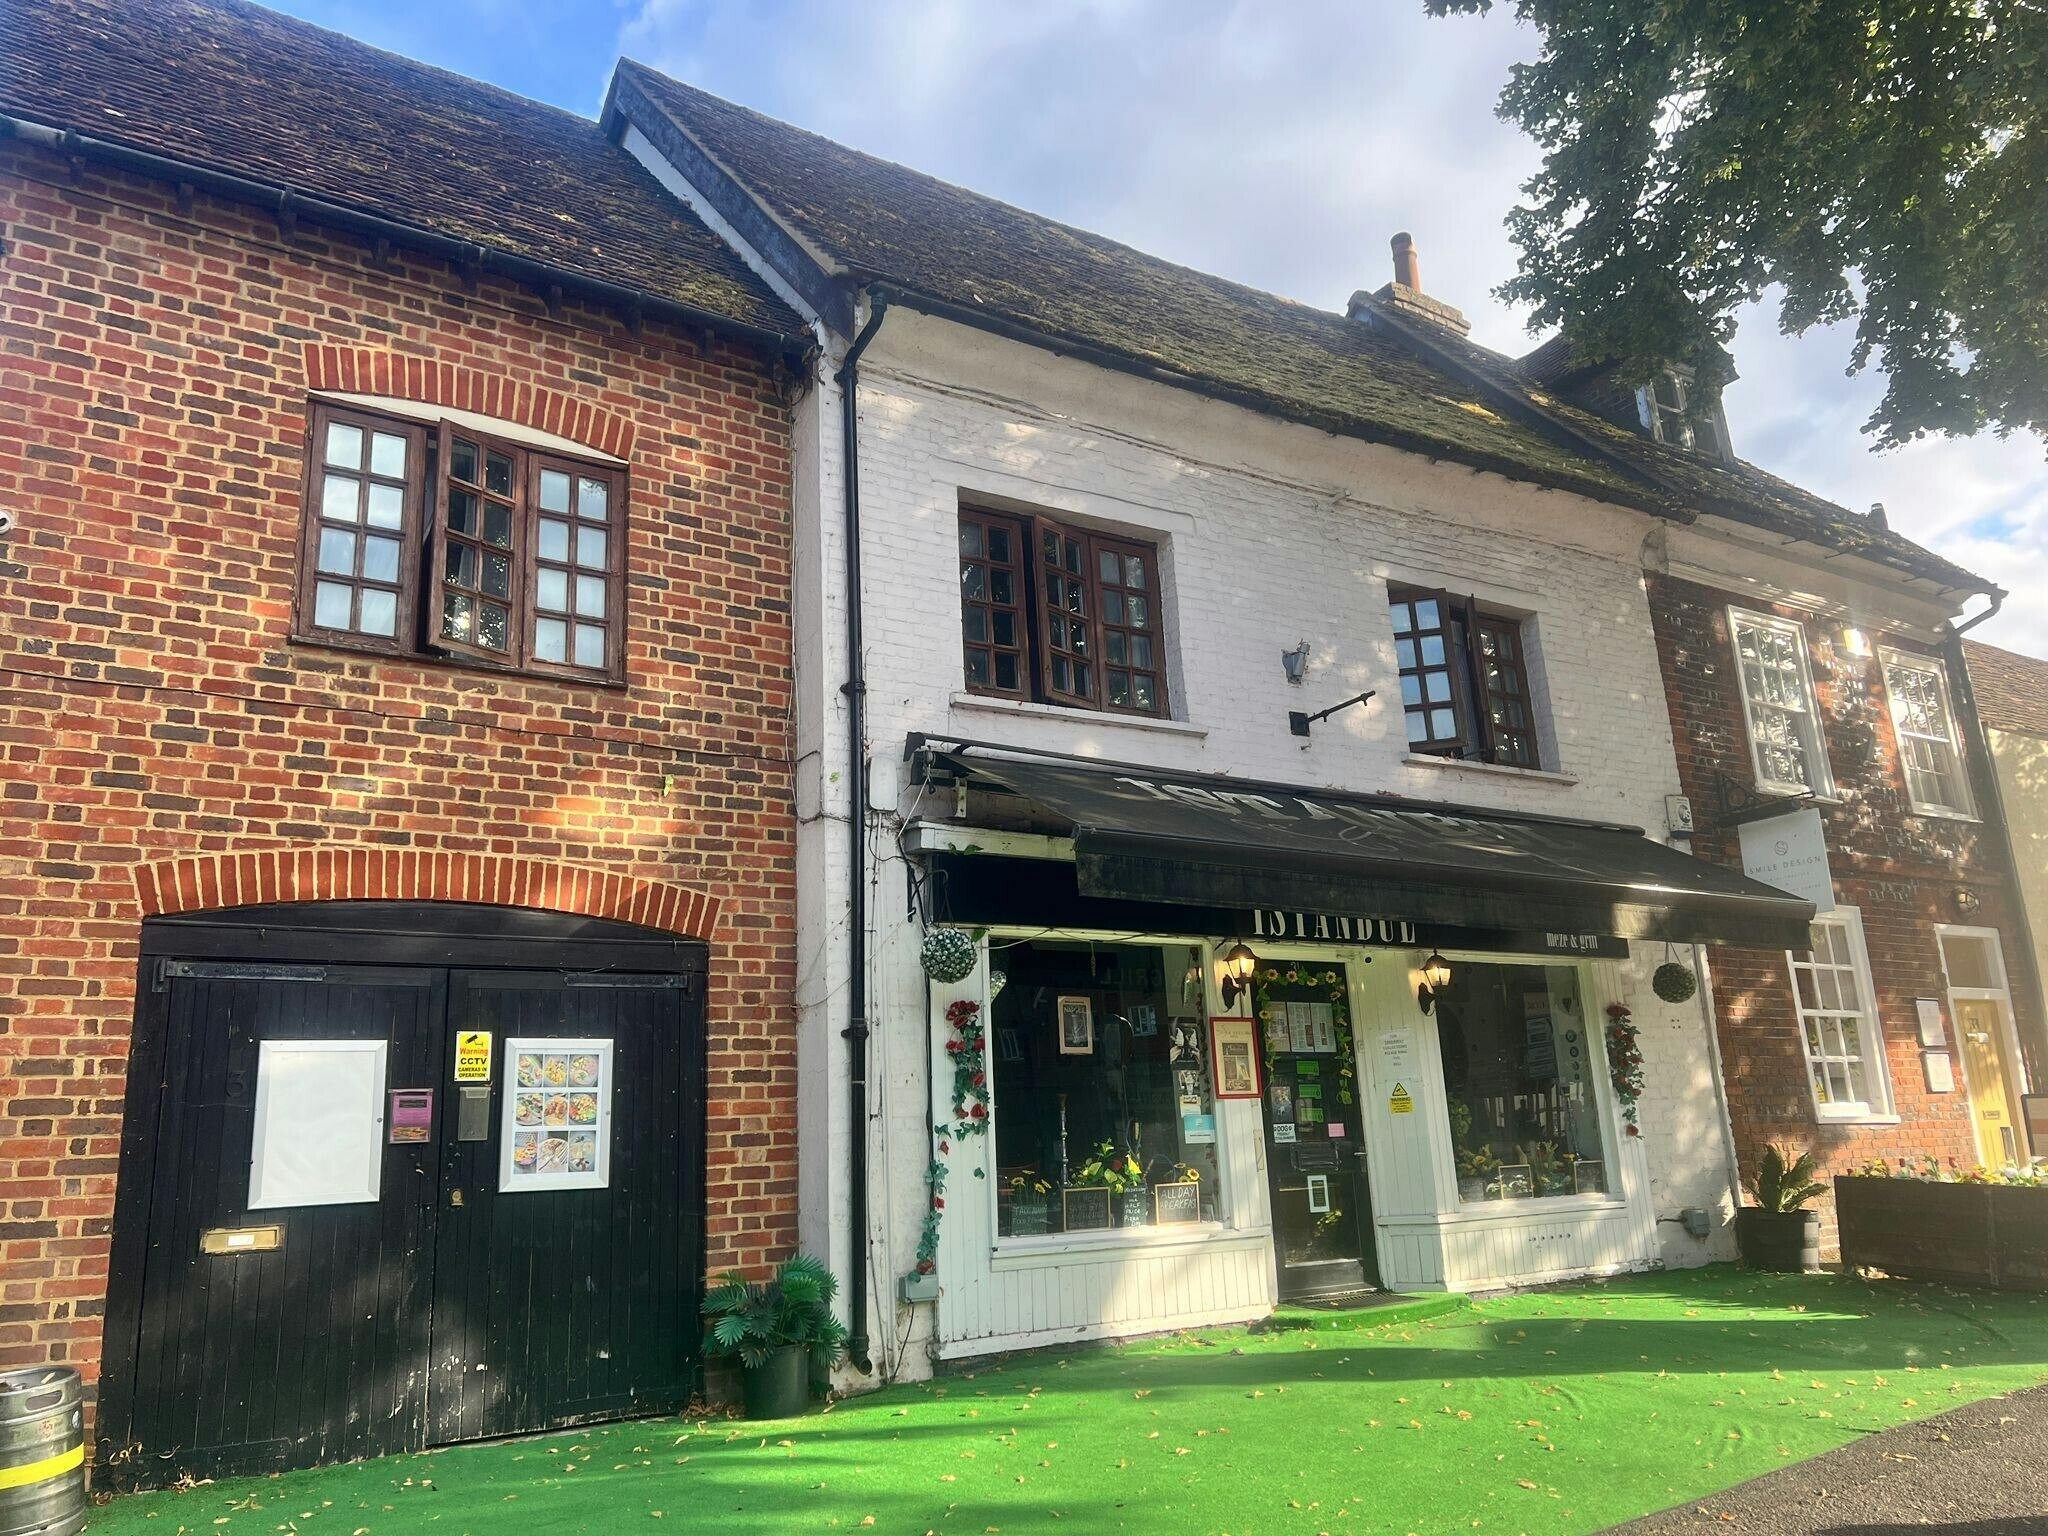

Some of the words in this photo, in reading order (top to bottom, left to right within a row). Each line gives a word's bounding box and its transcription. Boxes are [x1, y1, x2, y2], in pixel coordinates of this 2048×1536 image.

[1749, 864, 1777, 875] SMILE
[1783, 855, 1821, 868] DESIGN
[1546, 932, 1569, 948] meze
[1570, 934, 1579, 948] &
[1579, 935, 1599, 952] grill
[460, 1048, 488, 1056] Warning
[460, 1057, 487, 1065] CCTV
[1161, 1189, 1176, 1199] ALL
[1178, 1186, 1196, 1199] DAY
